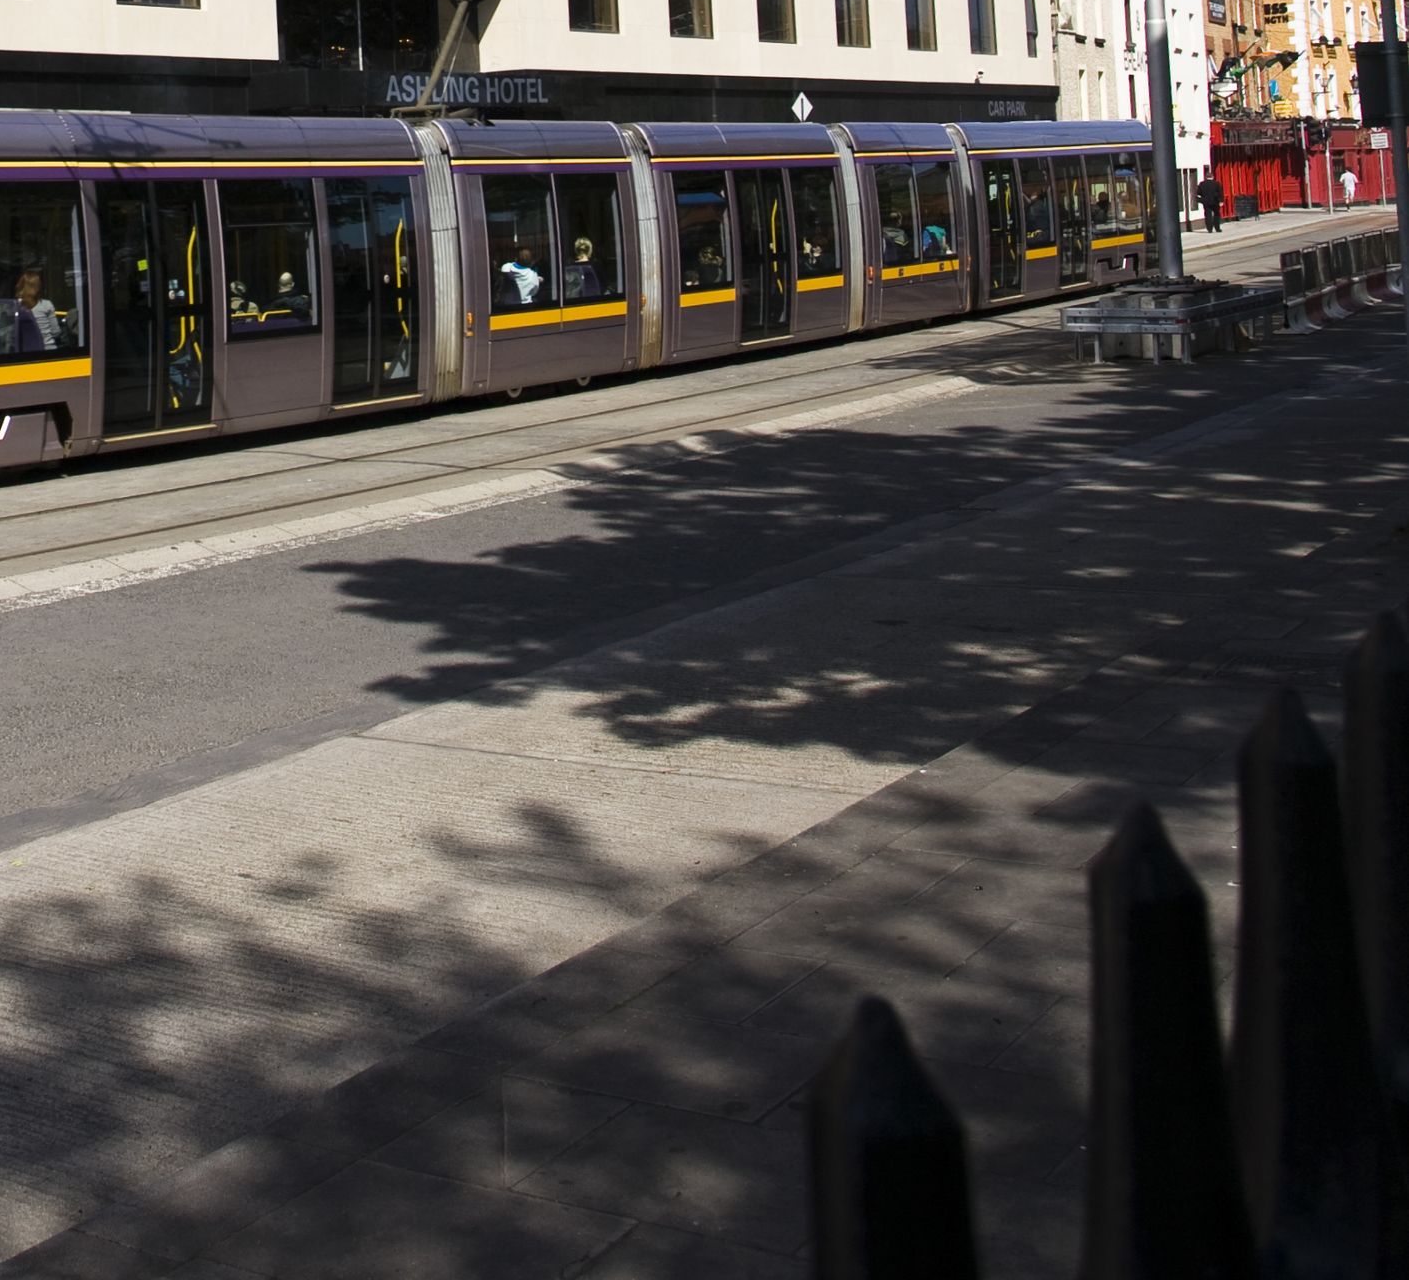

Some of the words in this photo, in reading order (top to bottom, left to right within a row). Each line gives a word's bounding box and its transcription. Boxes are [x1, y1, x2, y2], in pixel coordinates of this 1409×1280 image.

[486, 77, 549, 104] HOTEL
[988, 100, 1004, 116] CAR
[1006, 100, 1027, 116] PARK
